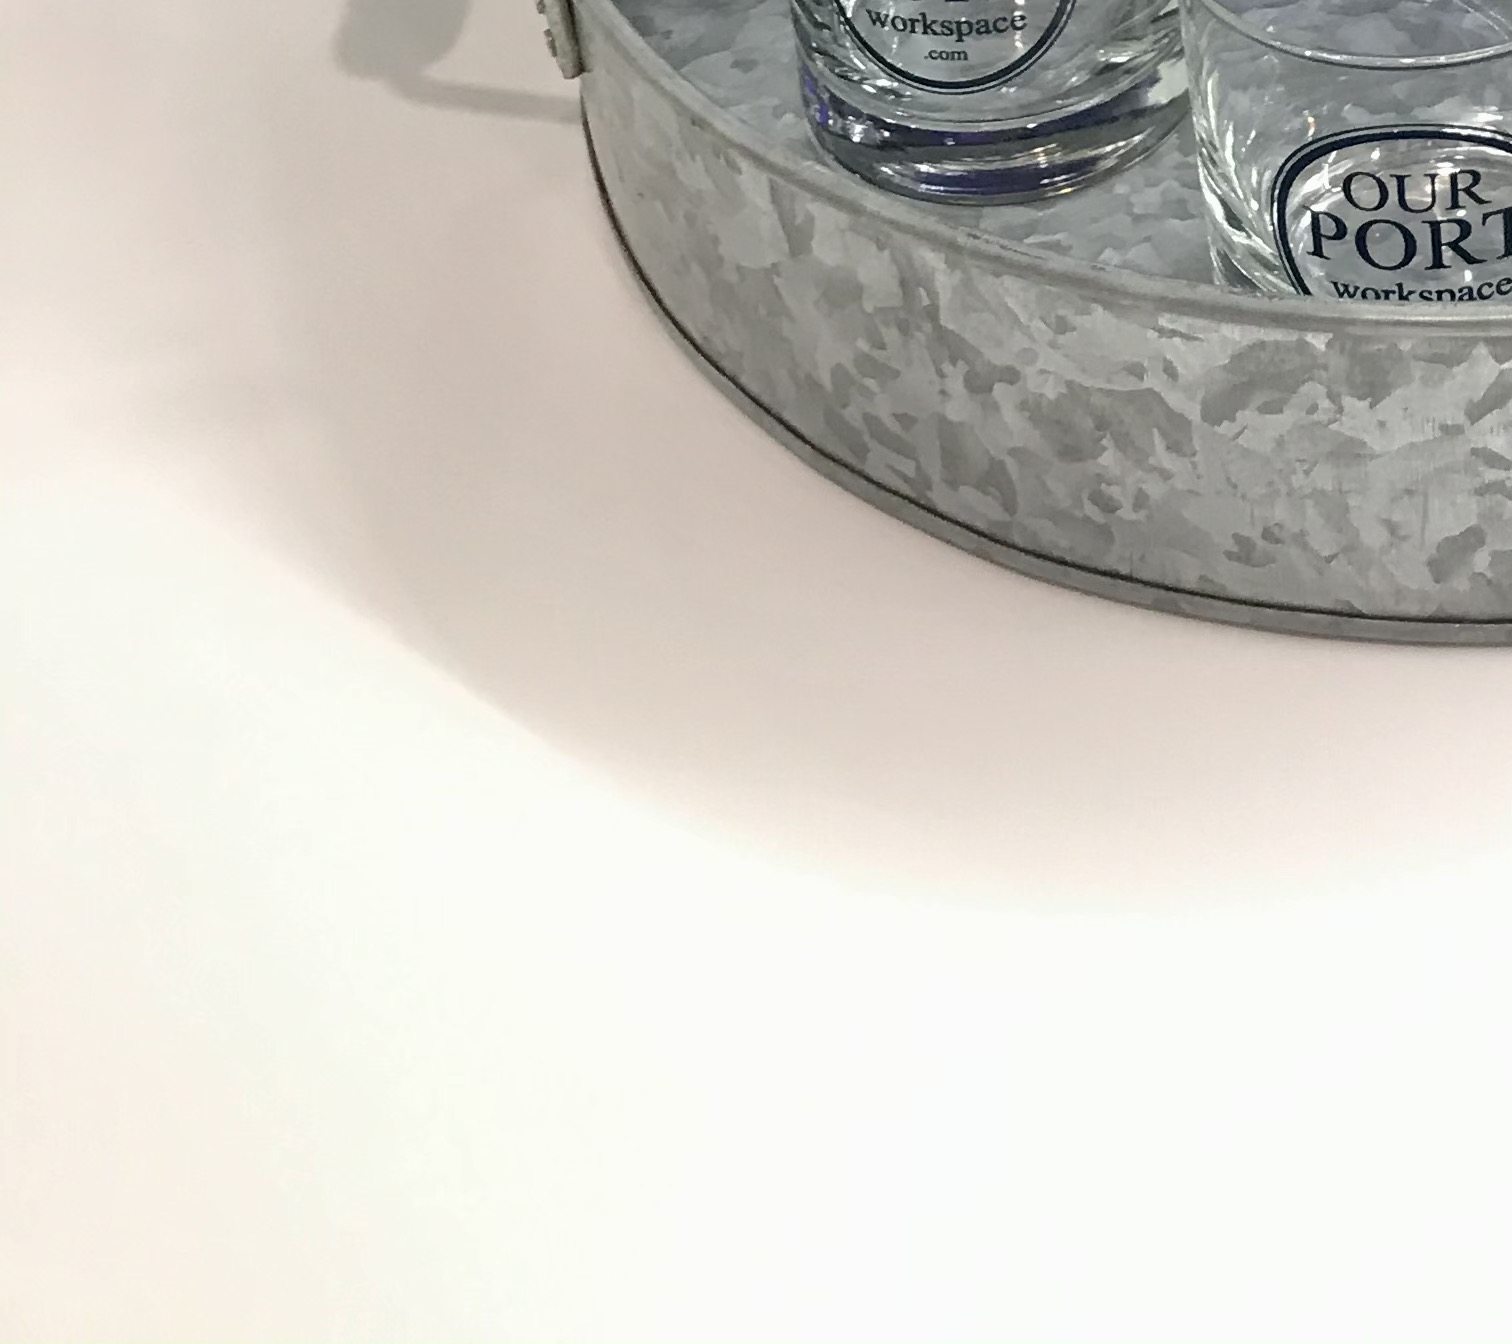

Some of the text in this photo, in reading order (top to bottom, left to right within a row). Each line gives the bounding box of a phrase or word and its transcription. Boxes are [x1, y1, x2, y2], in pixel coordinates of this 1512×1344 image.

[865, 8, 1028, 43] workspace
[923, 47, 969, 62] .com
[1342, 168, 1492, 213] OUR
